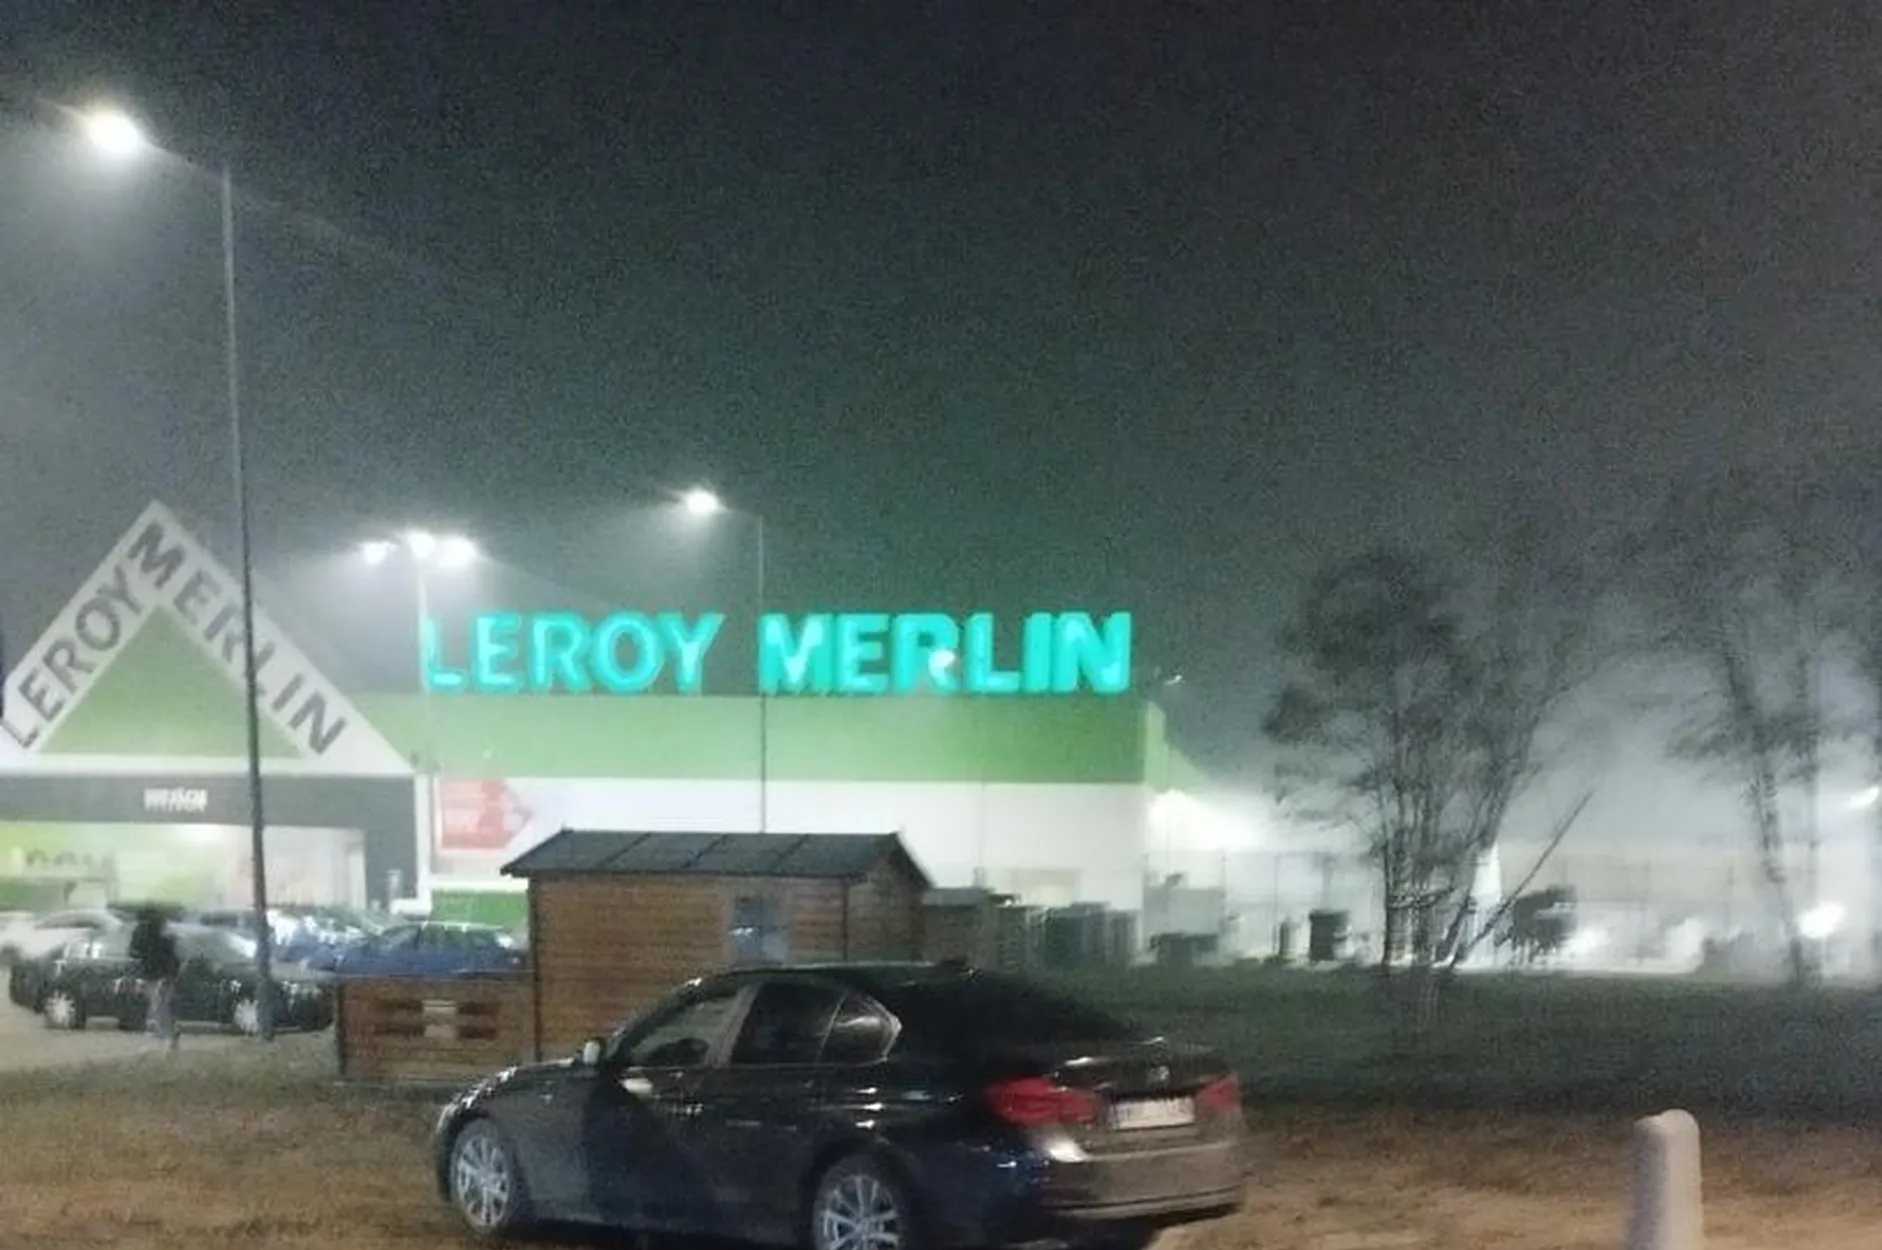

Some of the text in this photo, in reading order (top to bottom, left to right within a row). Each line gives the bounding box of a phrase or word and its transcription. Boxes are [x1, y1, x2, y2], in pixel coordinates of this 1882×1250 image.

[1, 565, 148, 749] LEROY
[421, 611, 1132, 693] LEROY MERLIN
